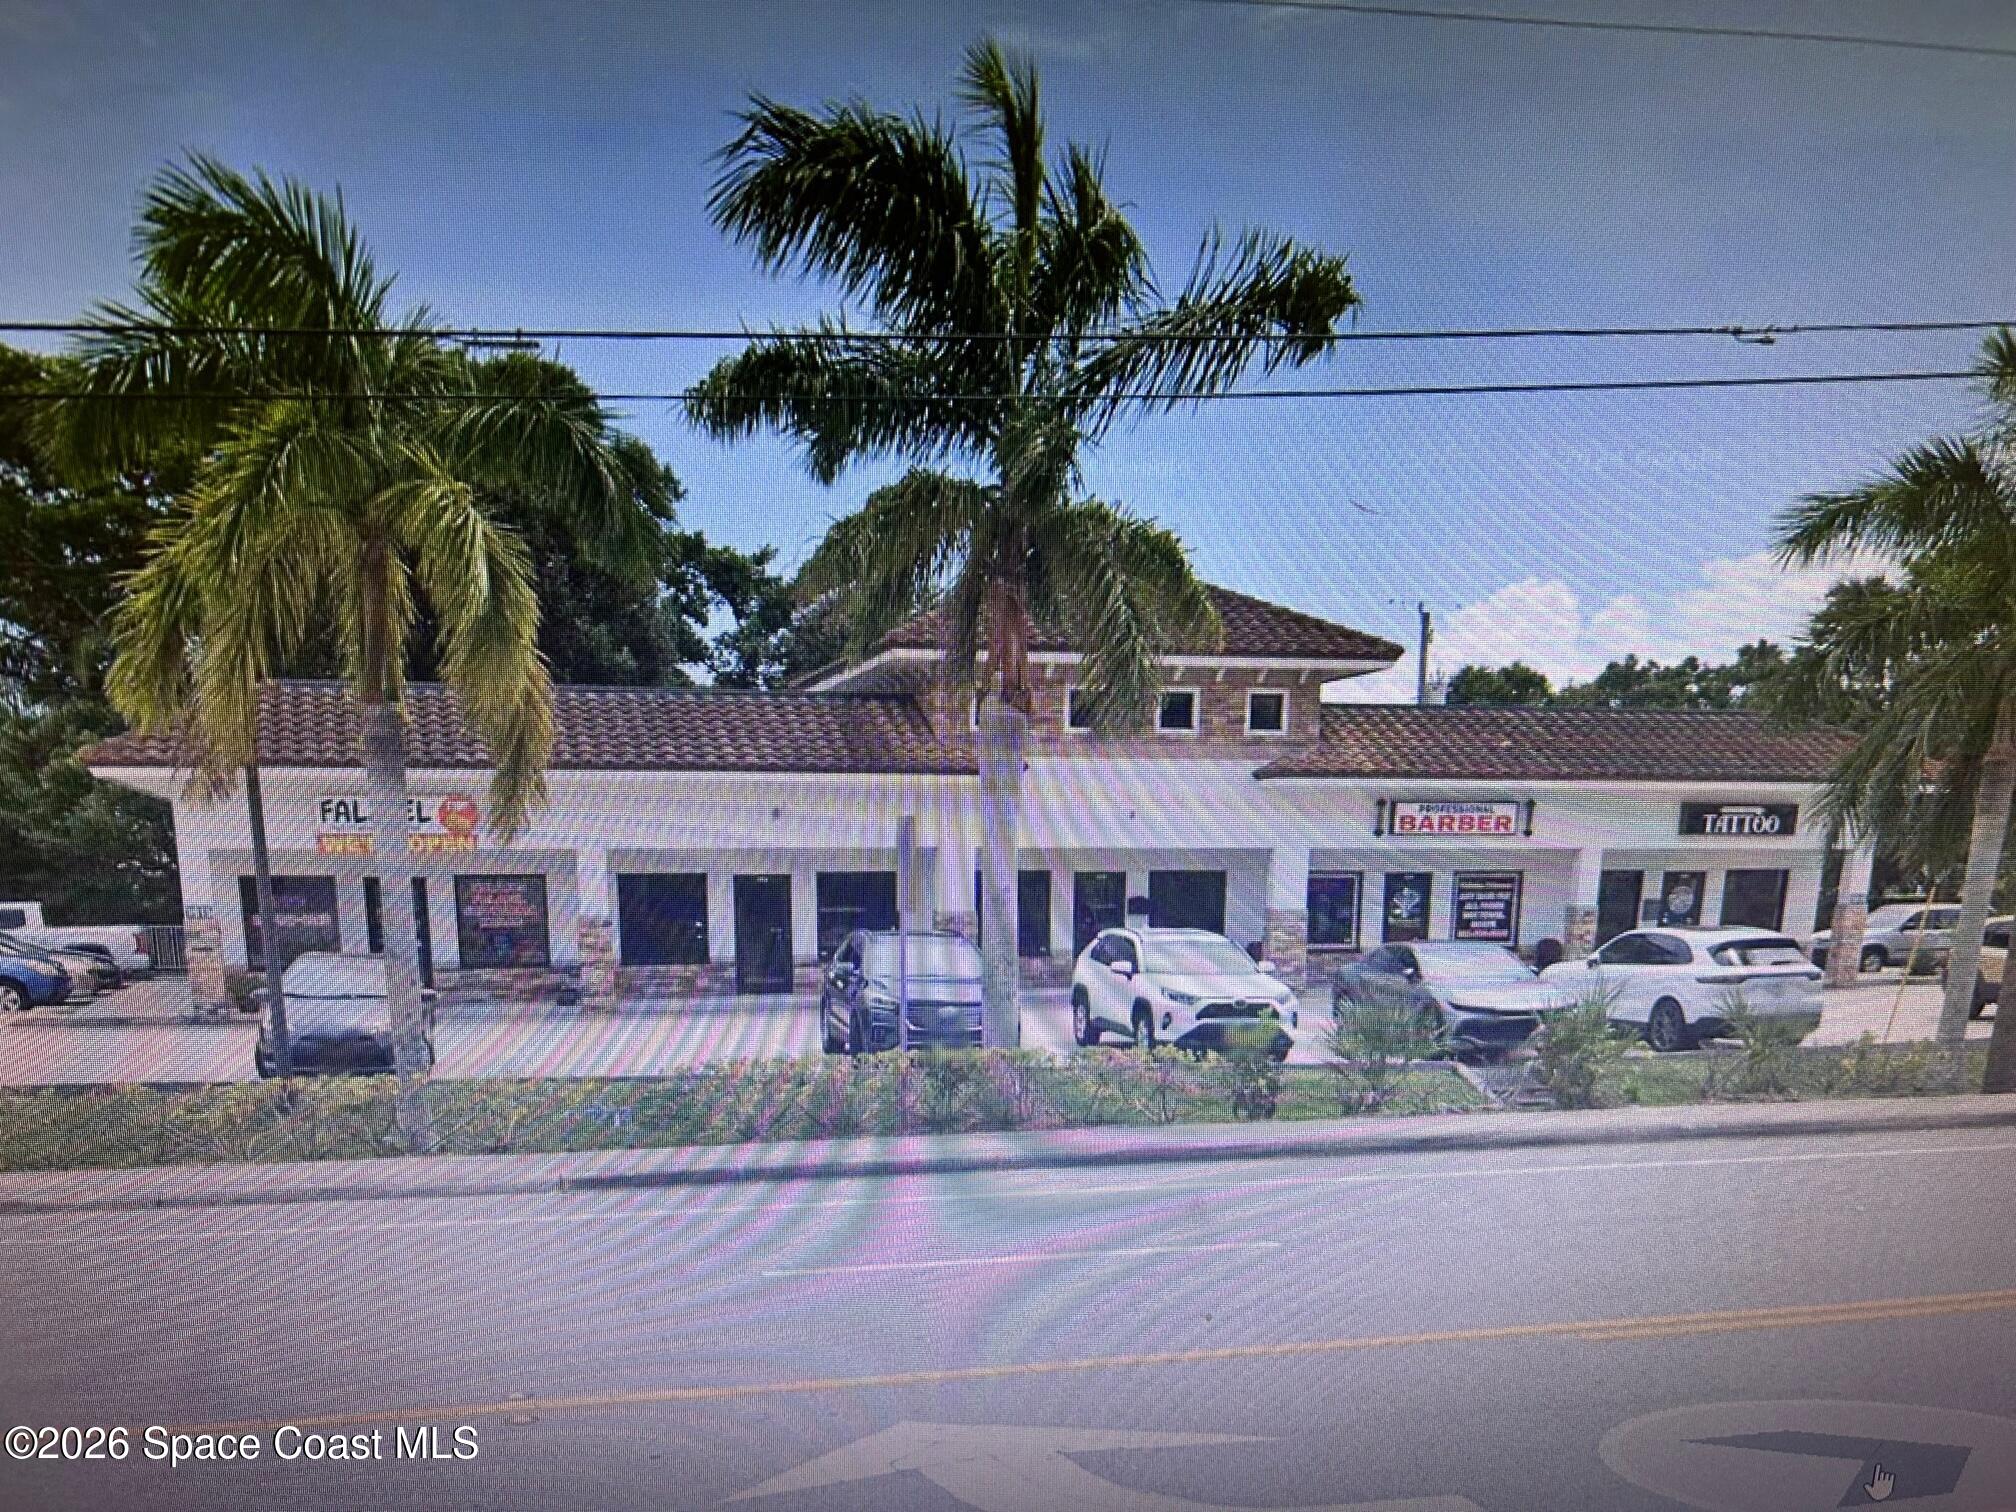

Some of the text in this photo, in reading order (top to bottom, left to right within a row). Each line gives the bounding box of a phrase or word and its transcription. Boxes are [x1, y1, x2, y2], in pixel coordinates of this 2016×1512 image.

[320, 799, 432, 823] FALEL
[1418, 804, 1495, 813] PROFESSIONAL
[1399, 814, 1513, 832] BARBER
[1703, 813, 1780, 833] TATTOO
[407, 834, 476, 852] OPEN
